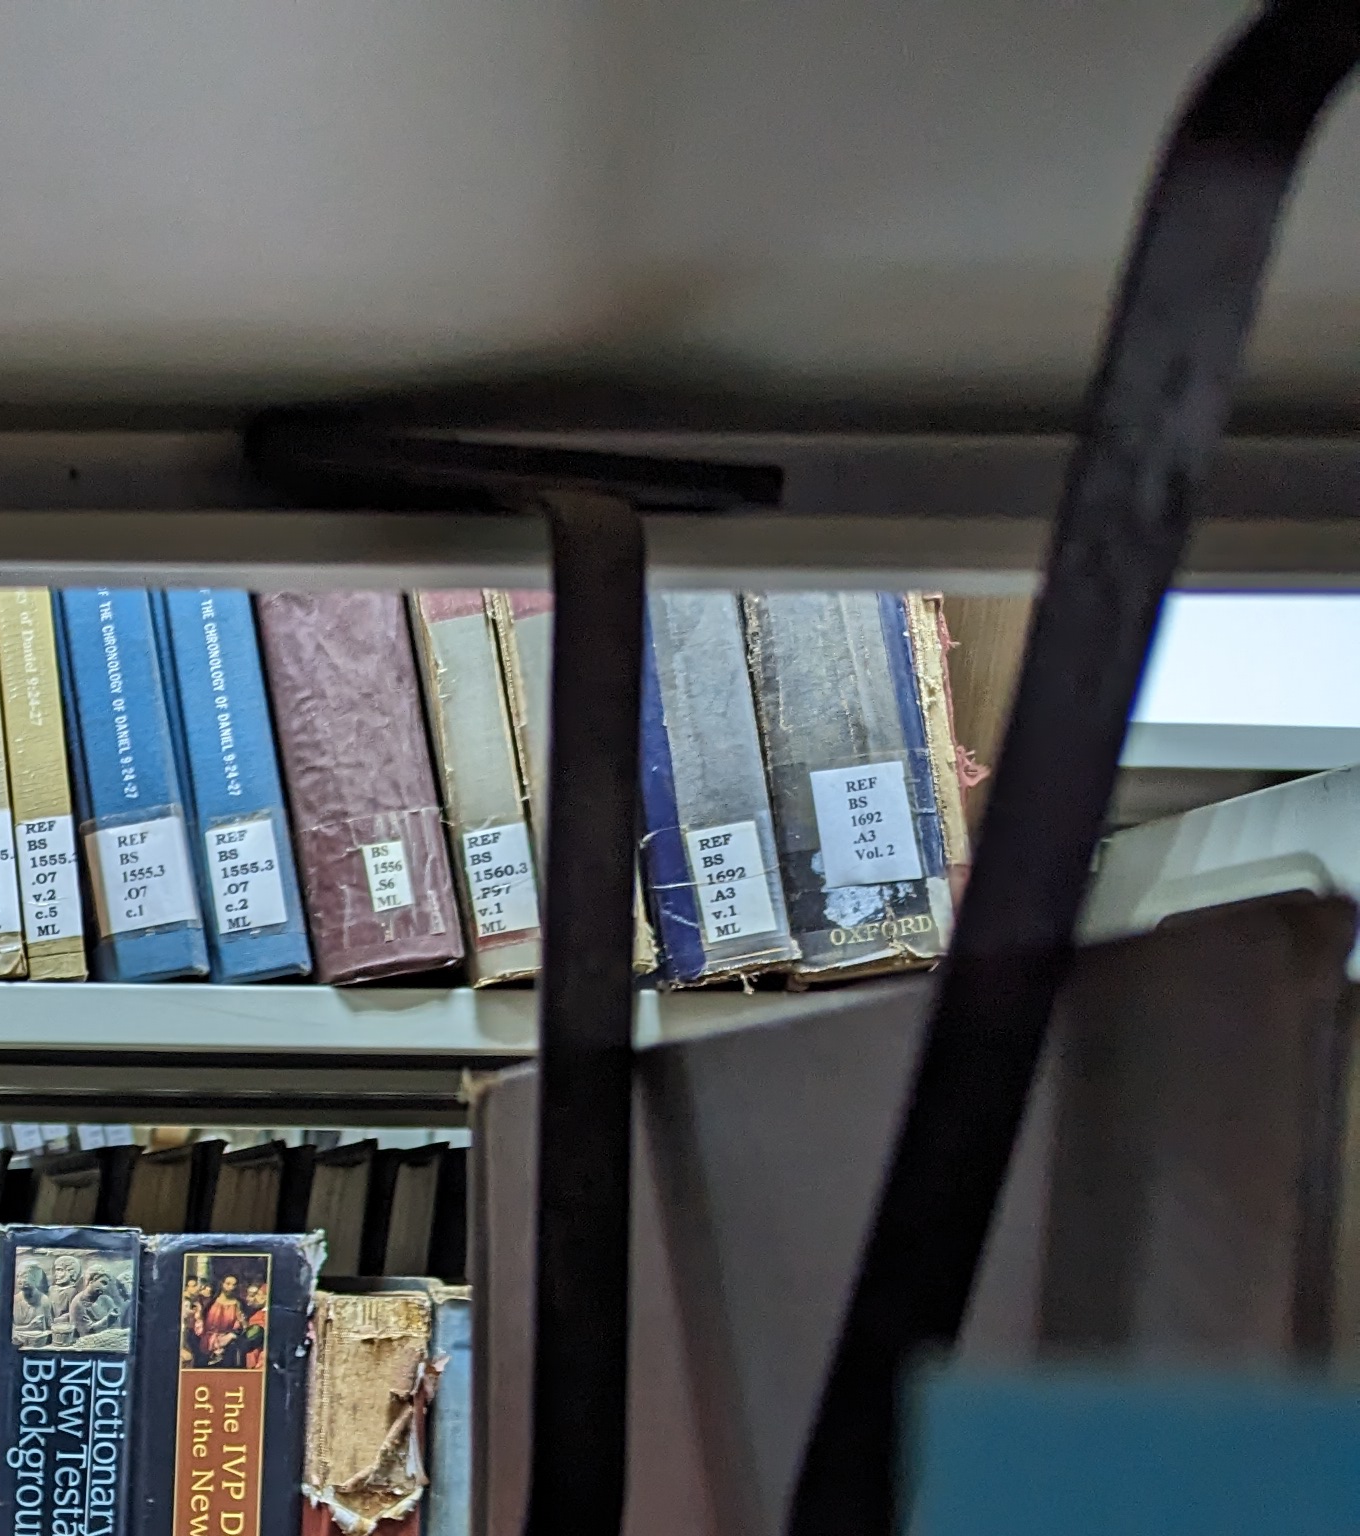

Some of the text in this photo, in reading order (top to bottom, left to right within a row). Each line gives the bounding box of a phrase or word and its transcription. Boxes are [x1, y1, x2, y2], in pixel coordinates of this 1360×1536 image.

[200, 599, 242, 796] THE CHRONOLOGY OF DANIEL 9:24-27
[846, 777, 877, 792] REF
[848, 797, 868, 810] BS
[851, 812, 883, 826] 1692
[216, 831, 247, 845] REF
[853, 831, 876, 844] .A3
[218, 850, 238, 861] BS
[856, 845, 895, 860] Vol. 2
[221, 861, 274, 878] 1555.3
[224, 882, 249, 896] .O7
[225, 900, 248, 912] c.2
[228, 916, 251, 929] ML
[830, 915, 932, 946] OXFORD
[58, 1358, 92, 1437] New
[194, 1386, 214, 1412] of
[224, 1386, 244, 1433] The
[192, 1420, 214, 1458] the
[222, 1443, 247, 1501] IVP
